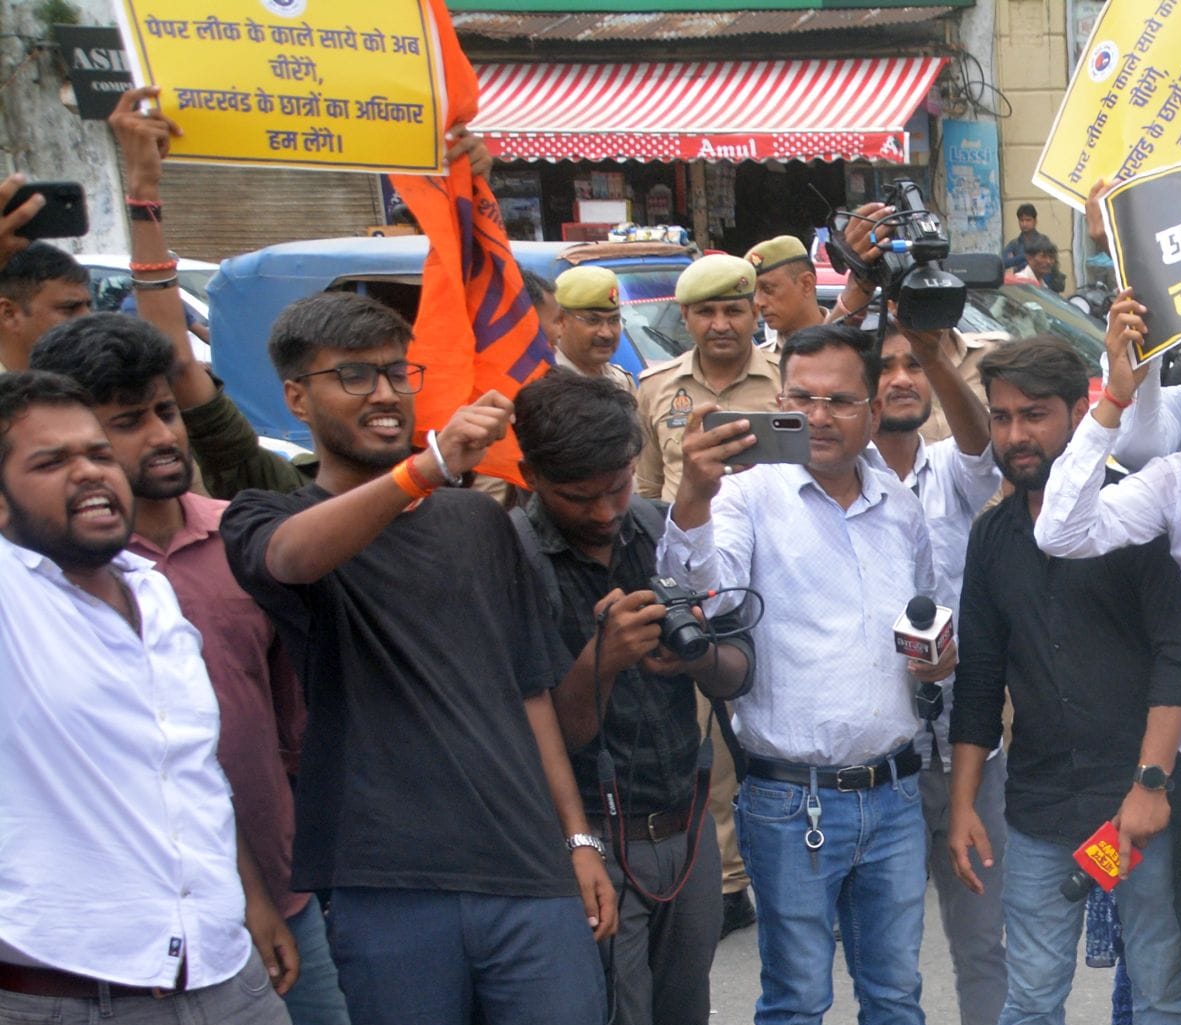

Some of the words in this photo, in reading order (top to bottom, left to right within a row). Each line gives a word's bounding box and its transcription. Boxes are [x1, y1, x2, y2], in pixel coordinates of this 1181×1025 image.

[145, 14, 190, 40] पेपर
[193, 16, 240, 41] लीक
[244, 18, 266, 43] के
[268, 22, 313, 48] काले
[317, 25, 359, 51] साये
[360, 28, 386, 53] को
[391, 35, 420, 56] अब
[268, 54, 324, 86] चीरेंगे,
[174, 86, 253, 113] झारखंड
[254, 87, 275, 113] के
[278, 91, 322, 119] छात्रों
[324, 98, 350, 120] का
[355, 96, 424, 125] अधिकार
[1068, 152, 1090, 185] पेपर
[1086, 112, 1109, 149] लीक
[1100, 90, 1119, 110] के
[1113, 52, 1142, 92] काले
[1134, 17, 1164, 53] साये
[266, 129, 298, 151] हम
[1142, 120, 1165, 140] के
[698, 138, 757, 158] Amul
